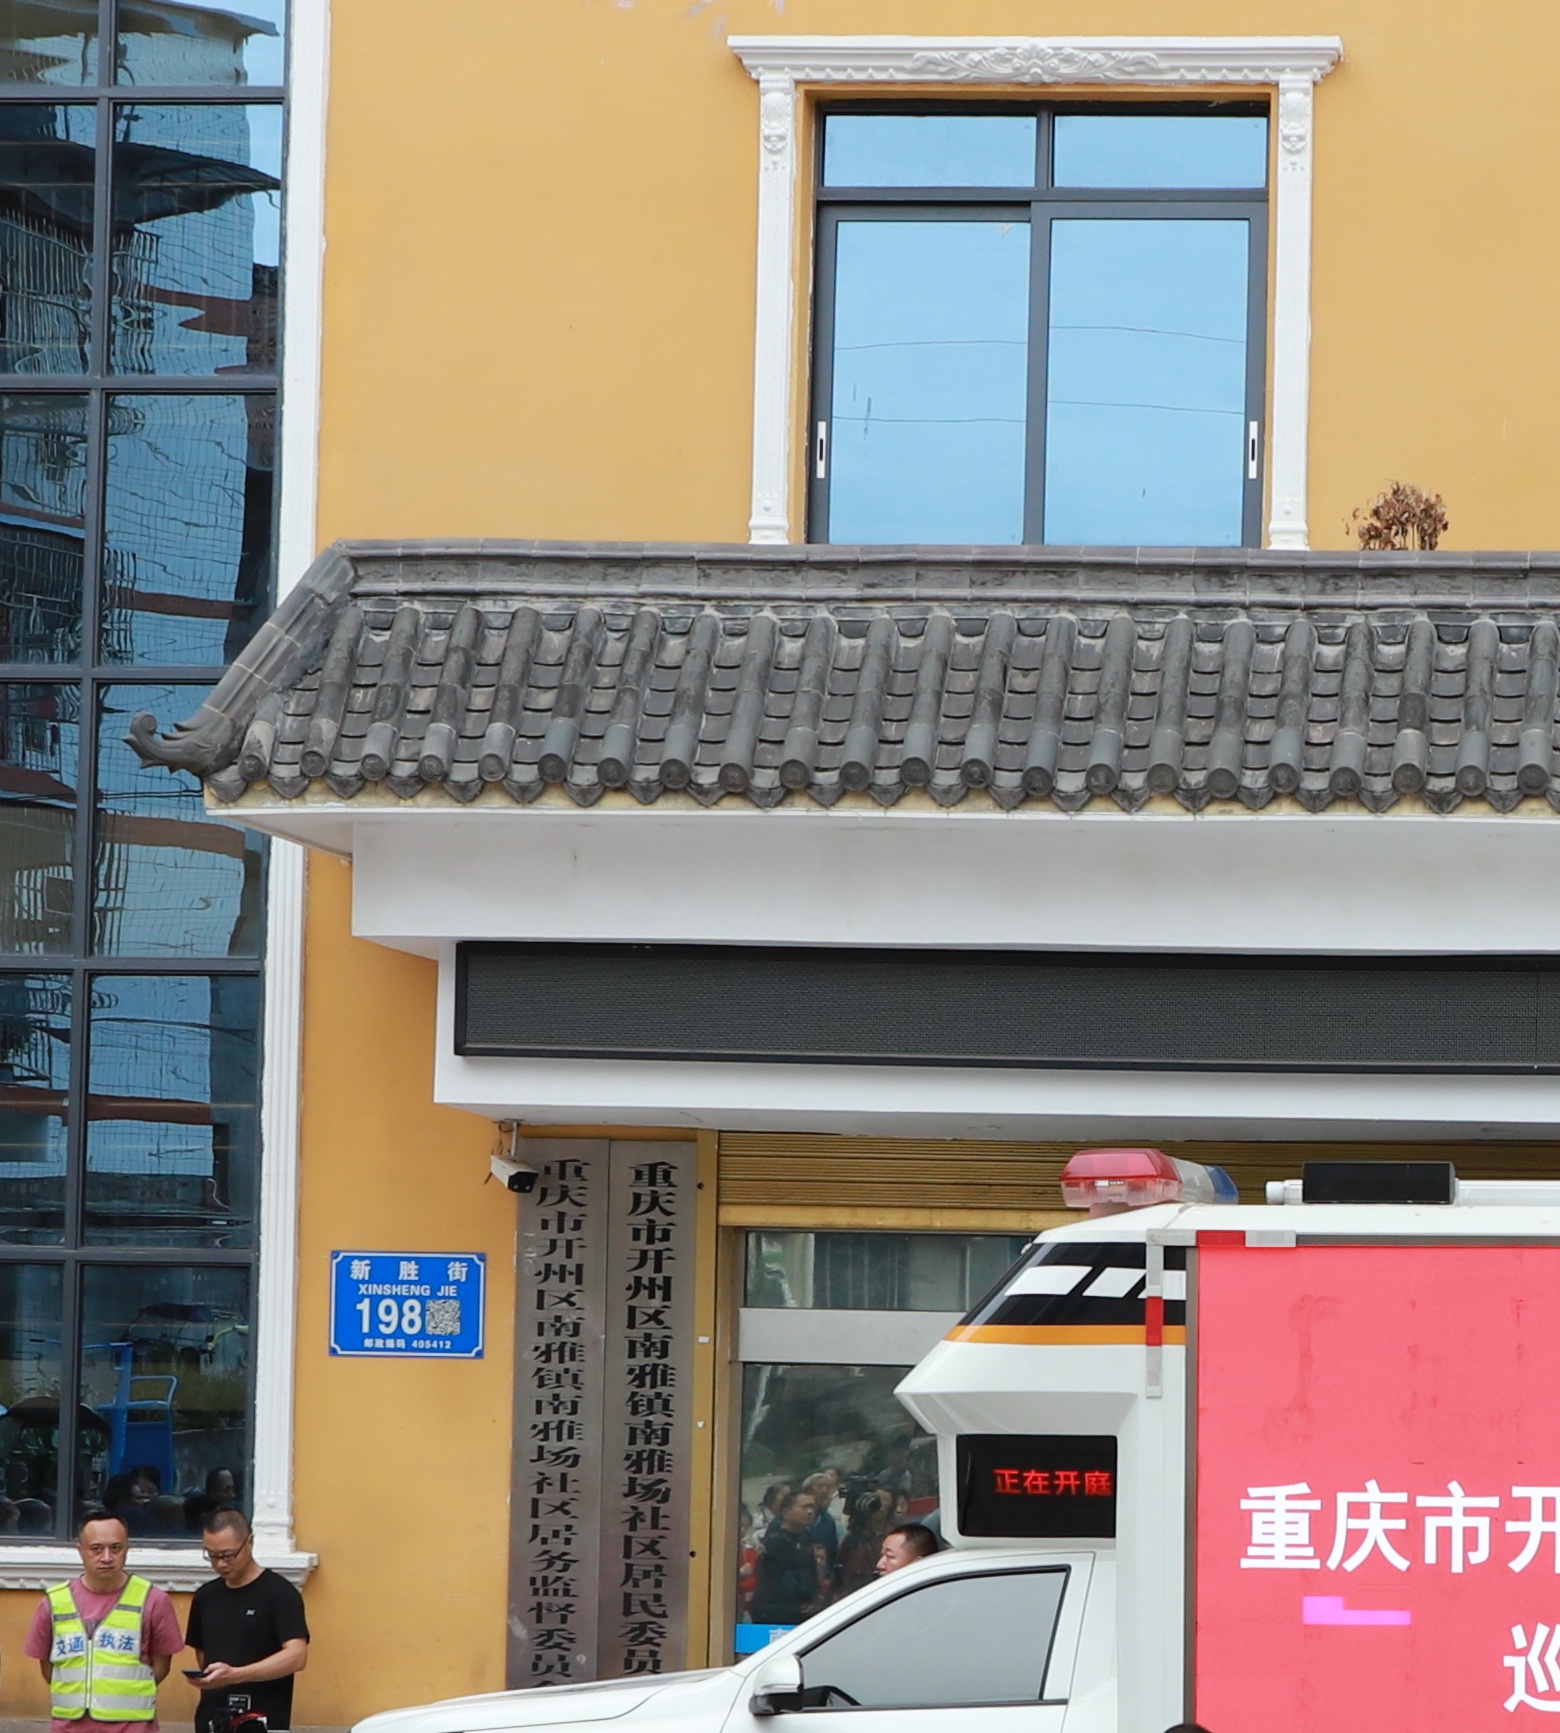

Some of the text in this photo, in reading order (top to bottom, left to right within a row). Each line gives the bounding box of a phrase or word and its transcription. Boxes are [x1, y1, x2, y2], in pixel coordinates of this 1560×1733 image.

[350, 1259, 469, 1283] 新胜街
[358, 1284, 458, 1297] XINSHENG JIE
[355, 1297, 423, 1335] 198
[411, 1338, 452, 1350] 405412
[527, 1158, 591, 1687] 重庆市开州区南雅镇南雅场社区居务监督委员
[993, 1468, 1113, 1497] 正在开庭
